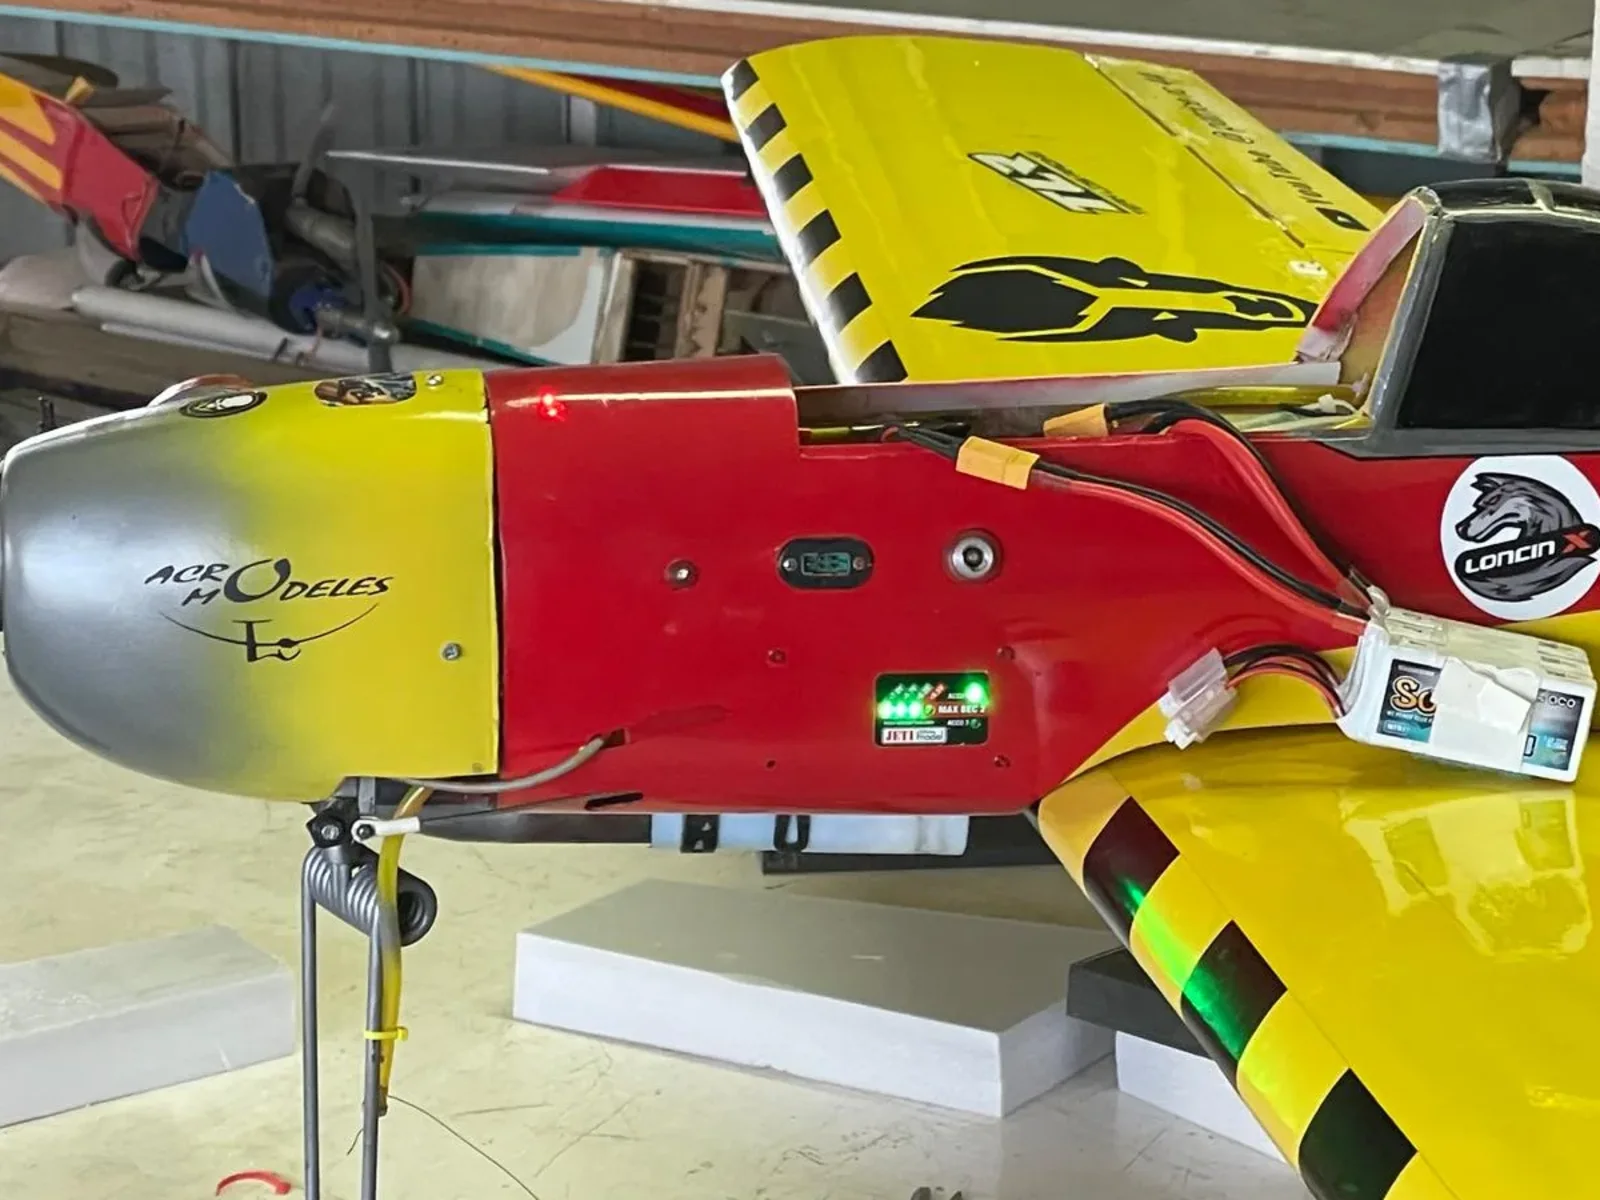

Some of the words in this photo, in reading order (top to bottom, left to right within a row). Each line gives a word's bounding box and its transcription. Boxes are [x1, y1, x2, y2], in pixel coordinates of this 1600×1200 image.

[1465, 541, 1556, 574] LONCIN
[1561, 529, 1592, 554] X
[938, 705, 959, 714] MAX
[886, 731, 914, 742] JETI
